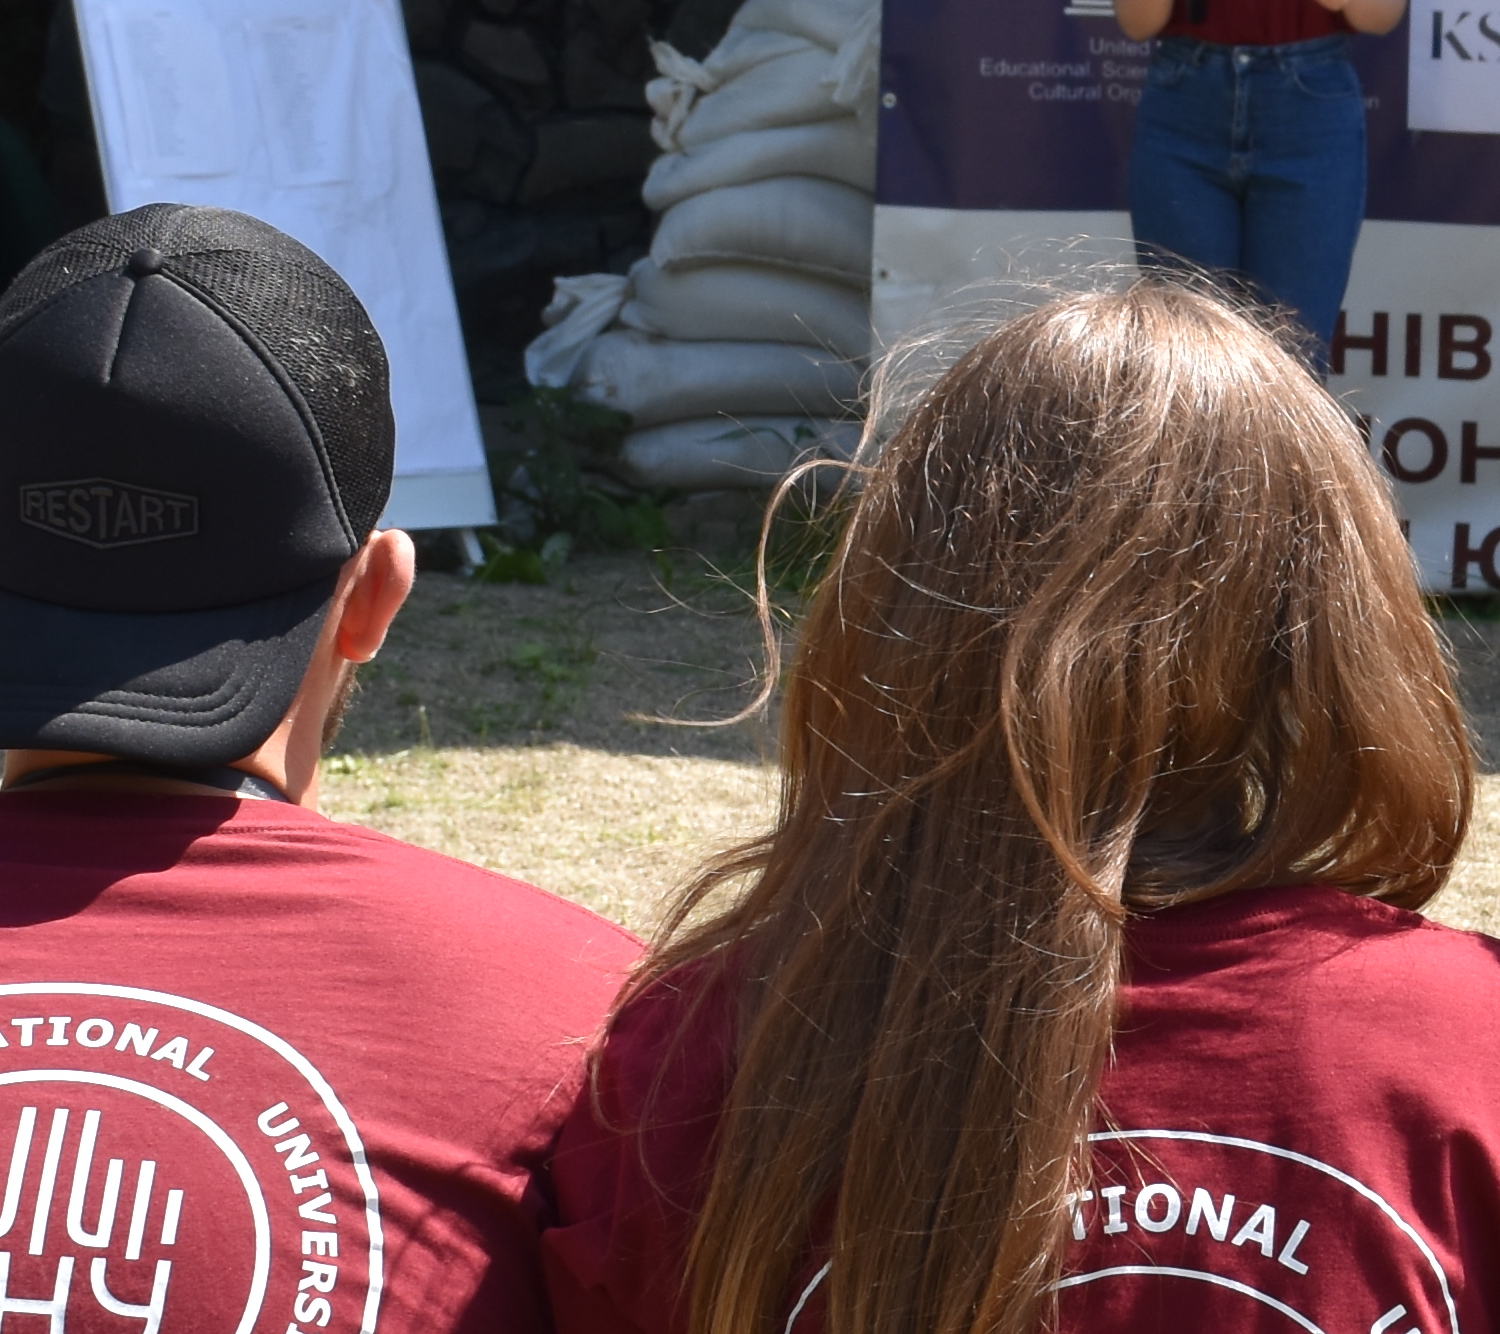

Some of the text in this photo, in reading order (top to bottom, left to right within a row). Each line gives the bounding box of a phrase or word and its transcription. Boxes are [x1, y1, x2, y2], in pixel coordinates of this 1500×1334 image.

[1089, 37, 1151, 57] United
[1028, 81, 1101, 102] Cultural
[26, 486, 190, 540] RESTART
[1065, 1183, 1312, 1275] TIONAL
